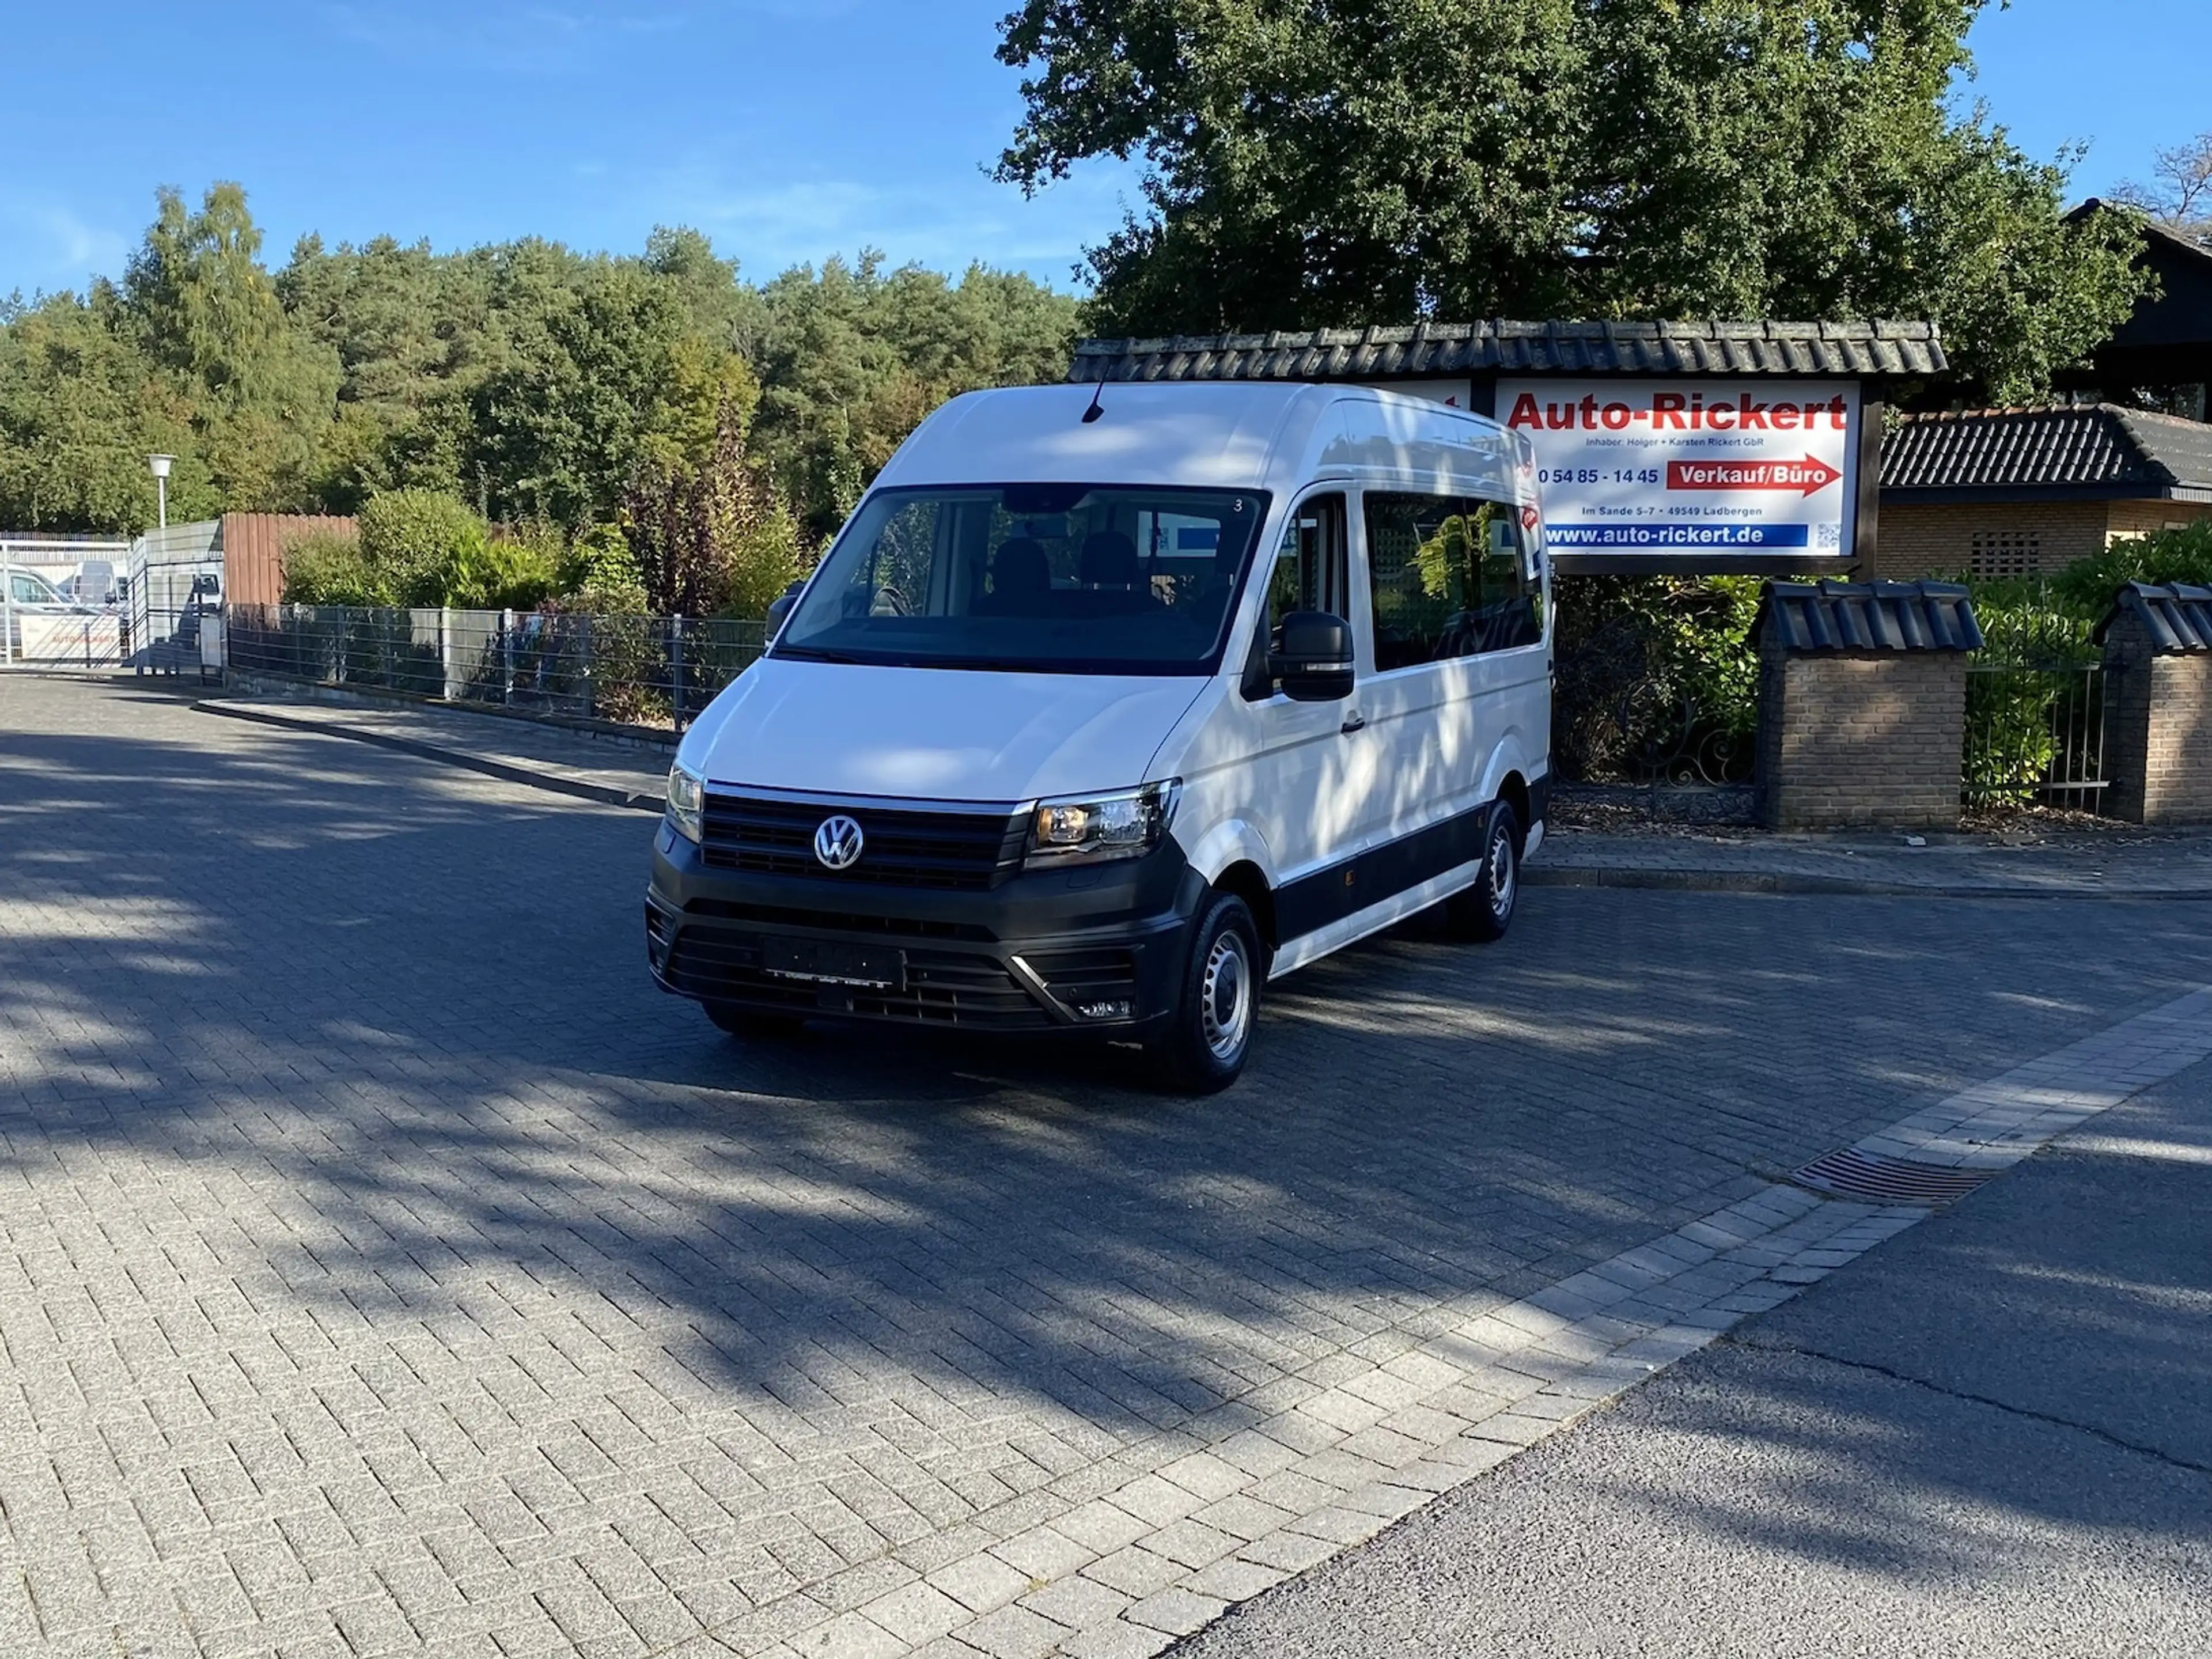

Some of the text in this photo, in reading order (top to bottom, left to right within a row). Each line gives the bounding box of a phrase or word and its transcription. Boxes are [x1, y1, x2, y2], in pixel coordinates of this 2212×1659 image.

[1508, 392, 1847, 430] Auto-Rickert
[1585, 438, 1624, 446] Inhaber:
[1627, 438, 1658, 448] Holger
[1669, 438, 1705, 446] Karsten
[1707, 438, 1741, 446] Rickert
[1743, 438, 1764, 446] GbR
[1538, 469, 1548, 483] 0
[1679, 465, 1827, 484] Verkauf/Büro
[1233, 498, 1243, 512] 3
[1582, 507, 1596, 516] Im
[1599, 507, 1633, 516] Sande
[1668, 507, 1700, 516] 49549
[1703, 506, 1762, 517] Ladbergen
[1546, 526, 1764, 543] www.auto-rickert.de
[815, 815, 863, 869] VW
